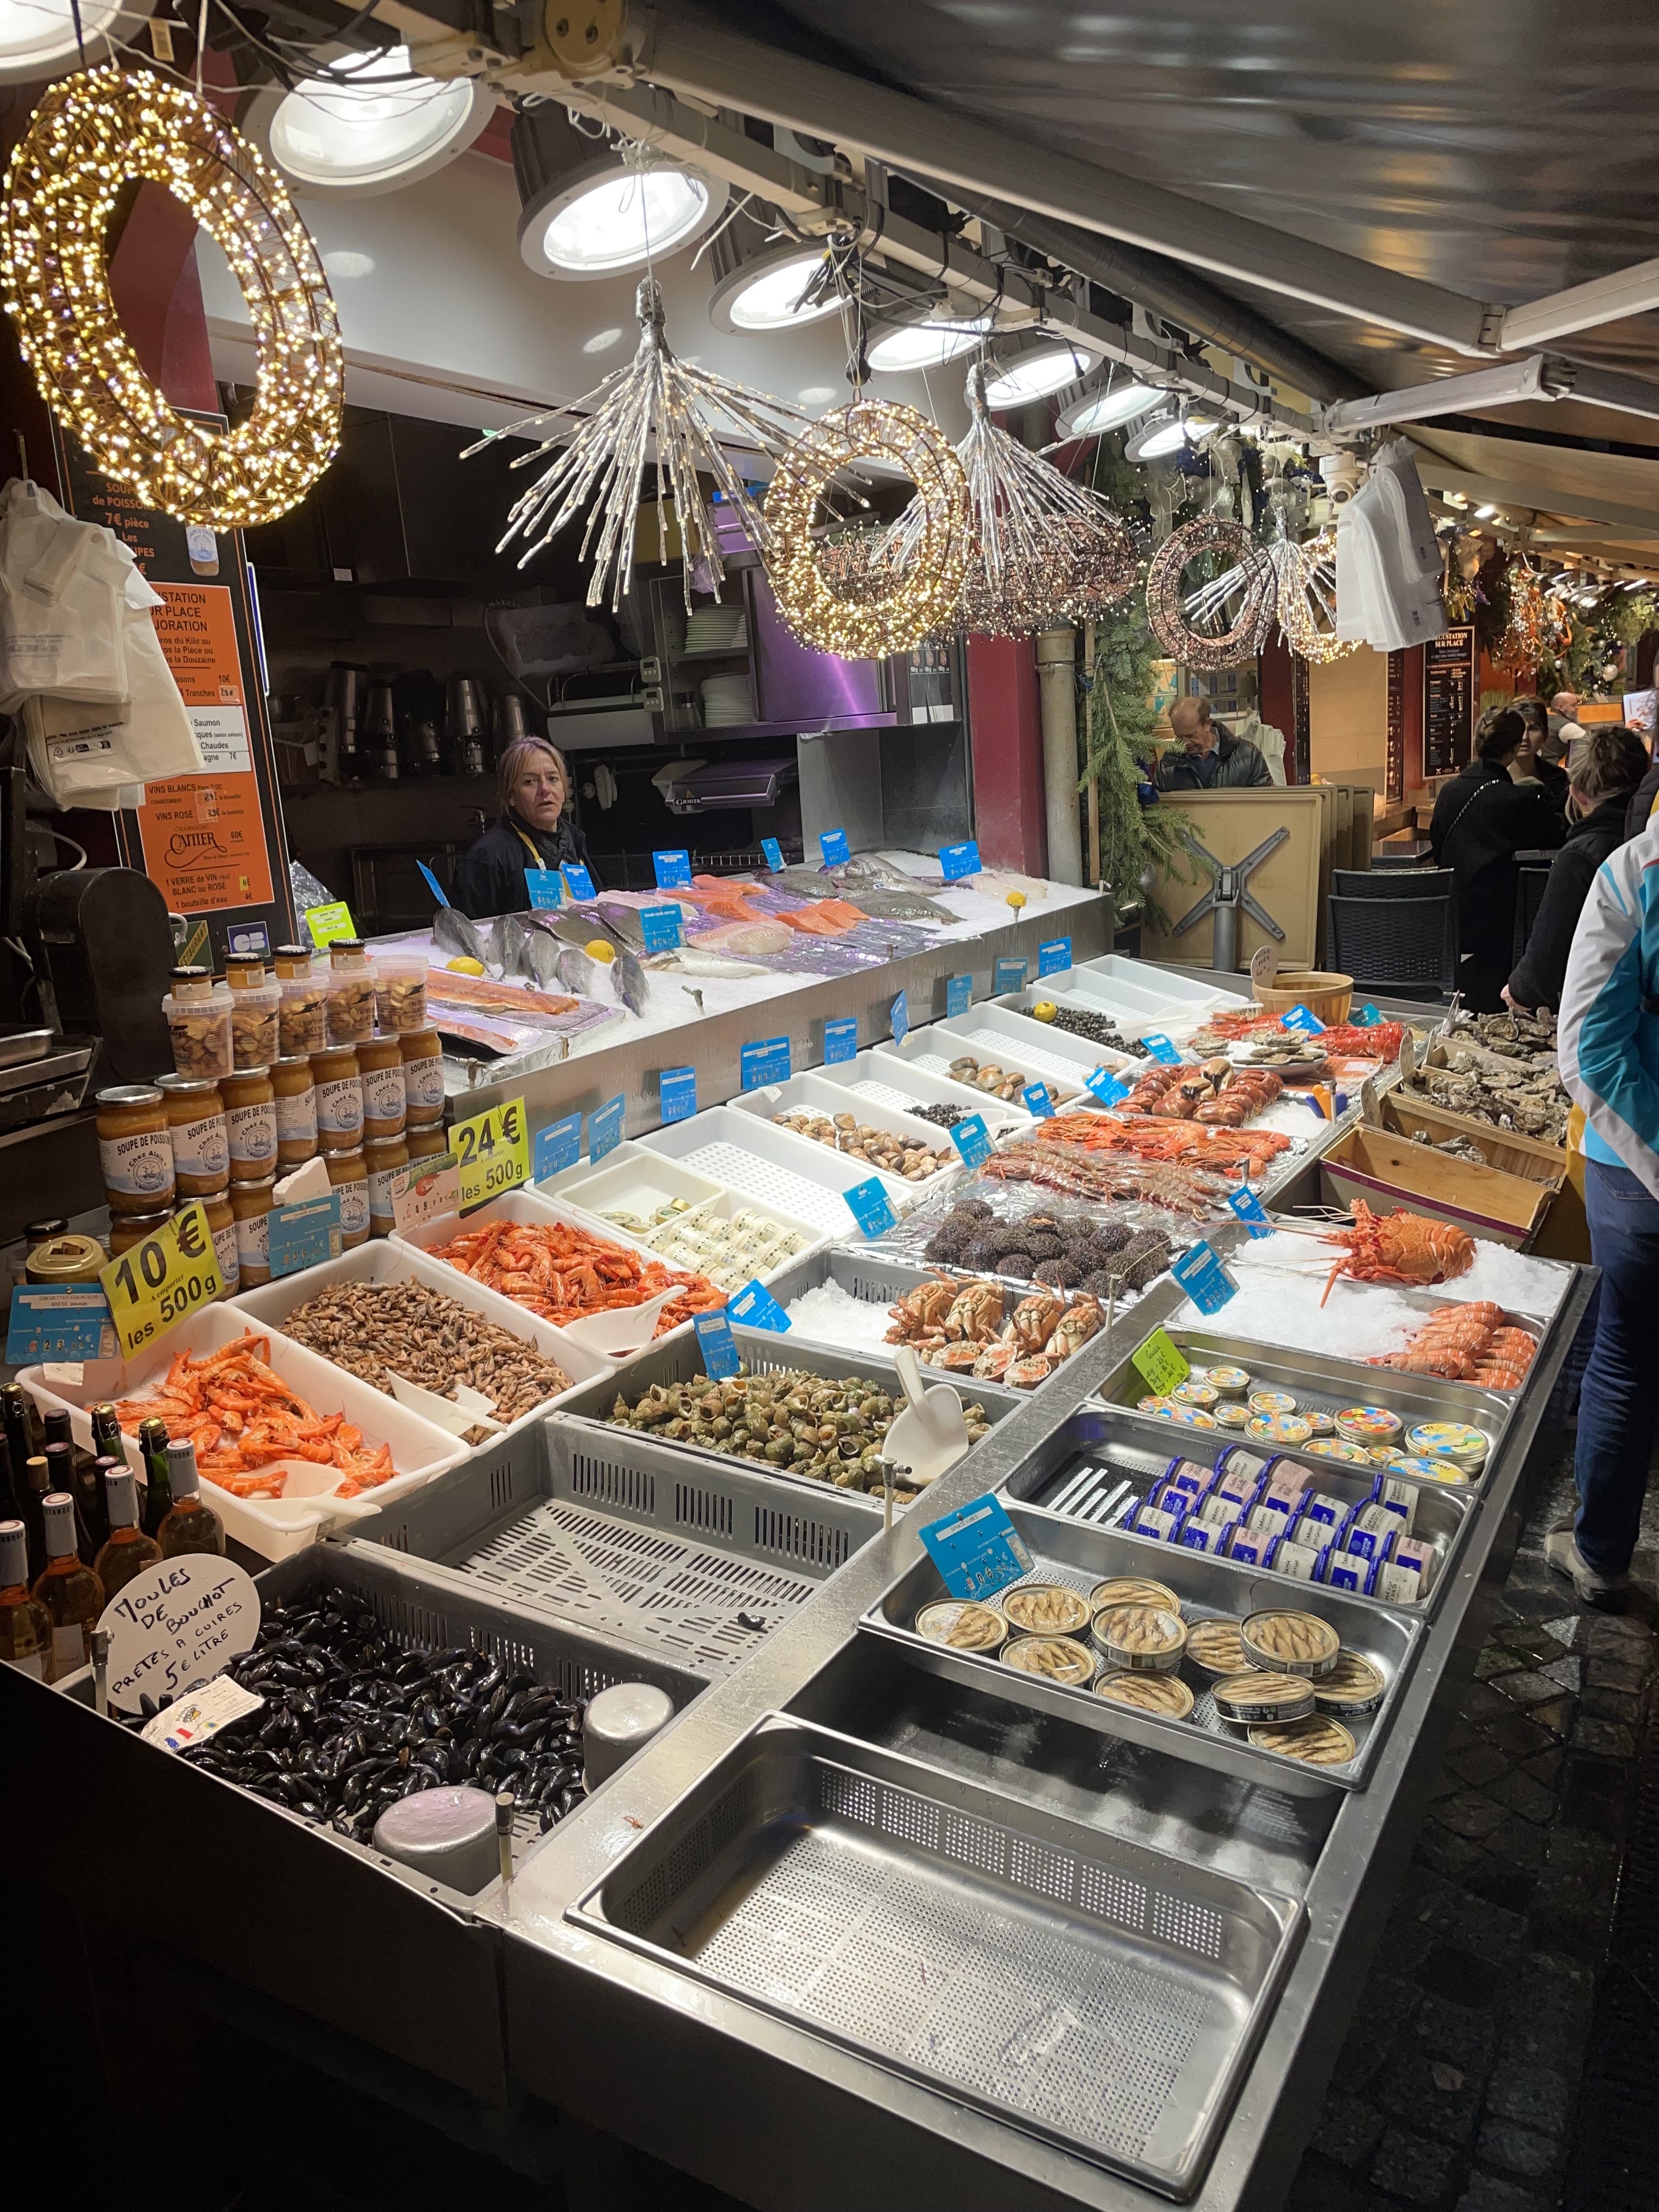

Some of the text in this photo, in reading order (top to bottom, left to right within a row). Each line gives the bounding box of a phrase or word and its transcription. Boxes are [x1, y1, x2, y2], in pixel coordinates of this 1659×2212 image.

[92, 495, 105, 505] de
[105, 512, 149, 529] 7€ pièce
[122, 532, 137, 542] Les
[166, 606, 201, 618] PLACE
[155, 619, 207, 631] JORATION
[1435, 640, 1446, 648] SUR
[229, 752, 237, 760] 7€
[149, 785, 166, 794] VINS
[168, 784, 196, 793] BLANCS
[155, 812, 172, 821] VINS
[171, 876, 194, 885] VERRE
[205, 873, 217, 882] VIN
[172, 885, 196, 896] BLANC
[242, 878, 251, 887] 6€
[182, 896, 208, 908] bouteille
[211, 896, 228, 904] d'eau
[410, 1060, 428, 1075] SOUPE
[428, 1058, 435, 1067] DE
[366, 1070, 391, 1087] SOUPE DE
[322, 1081, 349, 1098] SOUPE DE
[375, 1084, 389, 1097] Chez
[332, 1095, 346, 1108] Chez
[231, 1109, 251, 1125] SOUPE
[252, 1107, 259, 1116] DE
[187, 1122, 207, 1139] SOUPE
[209, 1118, 215, 1129] DE
[241, 1121, 257, 1136] Chez
[459, 1105, 521, 1168] 24 €
[117, 1136, 149, 1155] SOUPE DE
[199, 1135, 213, 1150] Chez
[129, 1150, 164, 1167] Chez Alain
[484, 1149, 504, 1163] emporter
[377, 1171, 395, 1186] SOUPE
[346, 1184, 352, 1193] DE
[461, 1183, 481, 1201] les
[352, 1196, 364, 1205] Alain
[249, 1216, 268, 1233] SOUPE
[114, 1209, 206, 1305] 10 €
[156, 1273, 184, 1297] emporter
[127, 1321, 154, 1350] les
[1210, 1504, 1220, 1523] TARAMA
[1257, 1512, 1268, 1530] TARAMA
[950, 1520, 967, 1533] SPRATS
[1305, 1524, 1314, 1542] TARAMA
[113, 1567, 191, 1623] MOULES
[166, 1577, 235, 1636] BOUCHOT
[140, 1603, 168, 1630] DE
[112, 1601, 242, 1694] PRETES A CUIRES
[193, 1628, 229, 1661] LITRE
